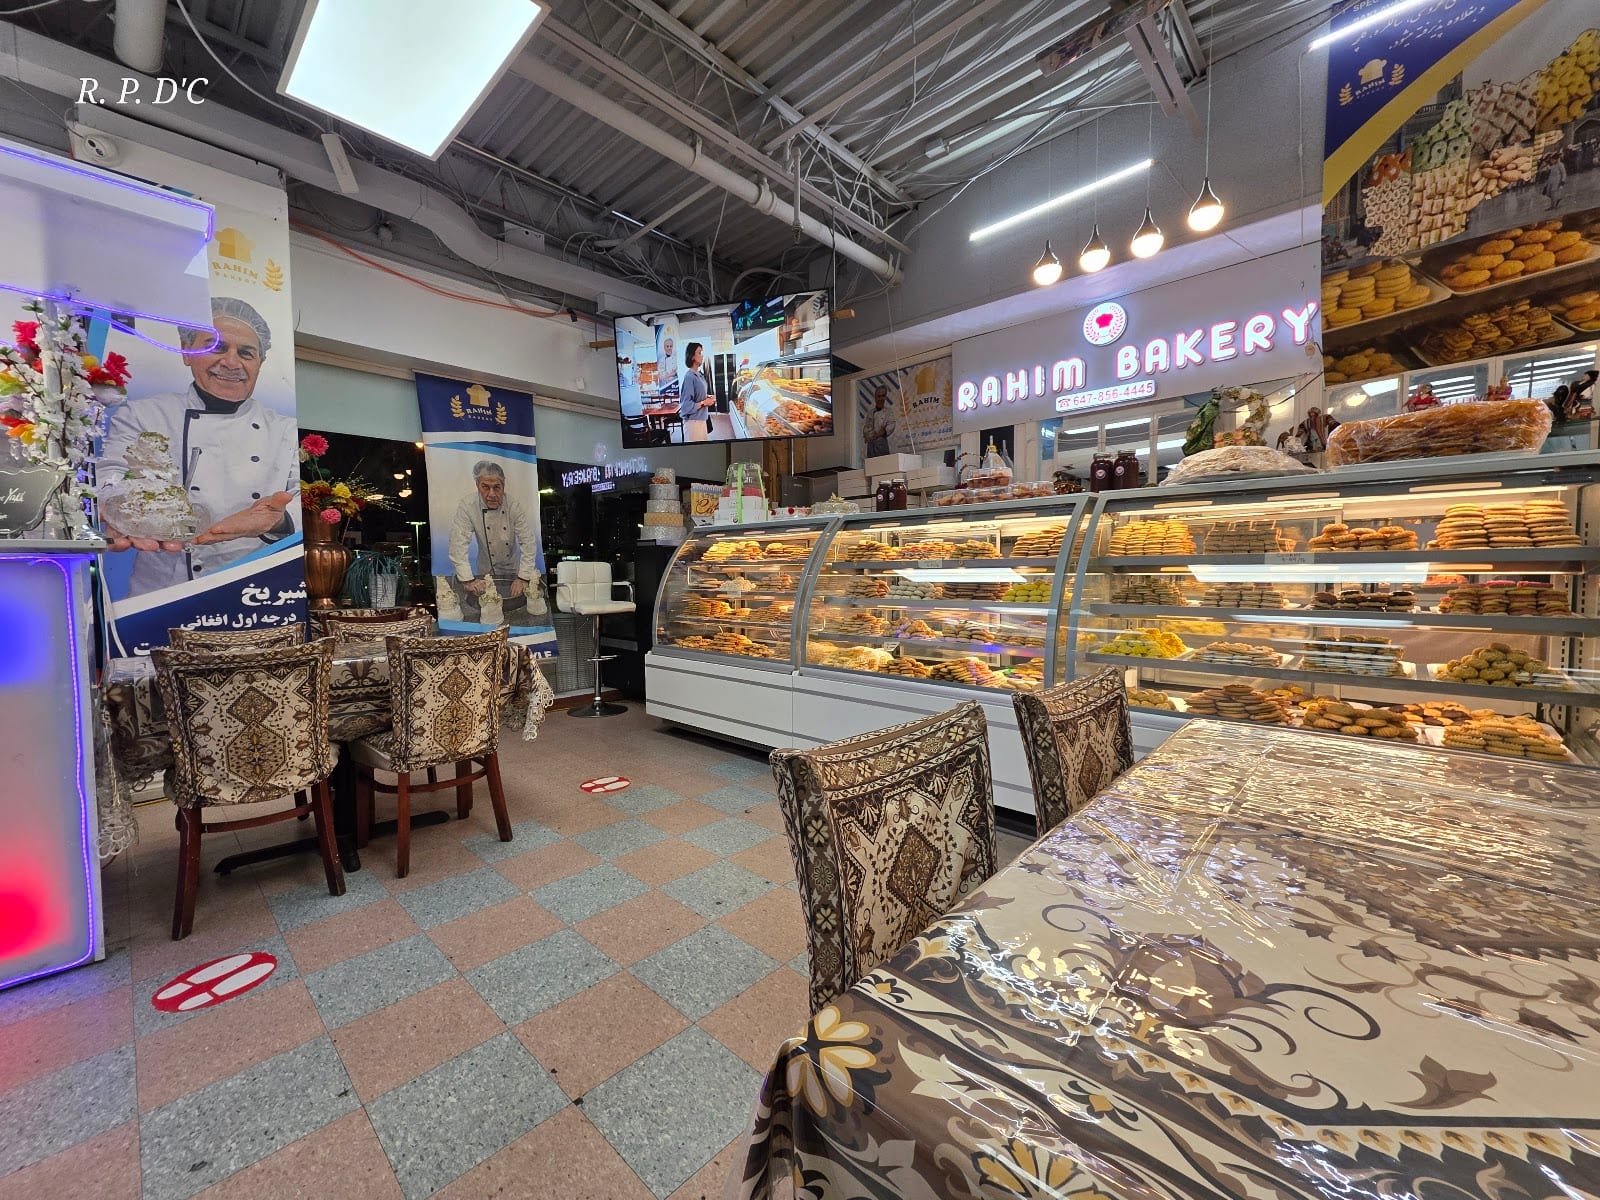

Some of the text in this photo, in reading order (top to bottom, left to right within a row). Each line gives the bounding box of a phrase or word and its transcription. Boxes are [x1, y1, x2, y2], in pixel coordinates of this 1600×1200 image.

[212, 261, 258, 279] RAHIM
[957, 301, 1319, 412] RAHIM BAKERY
[912, 396, 940, 409] RAHIM
[1072, 382, 1154, 407] 647-856-4445
[466, 407, 493, 415] RAHIM
[180, 612, 297, 631] درجه اول افغانی
